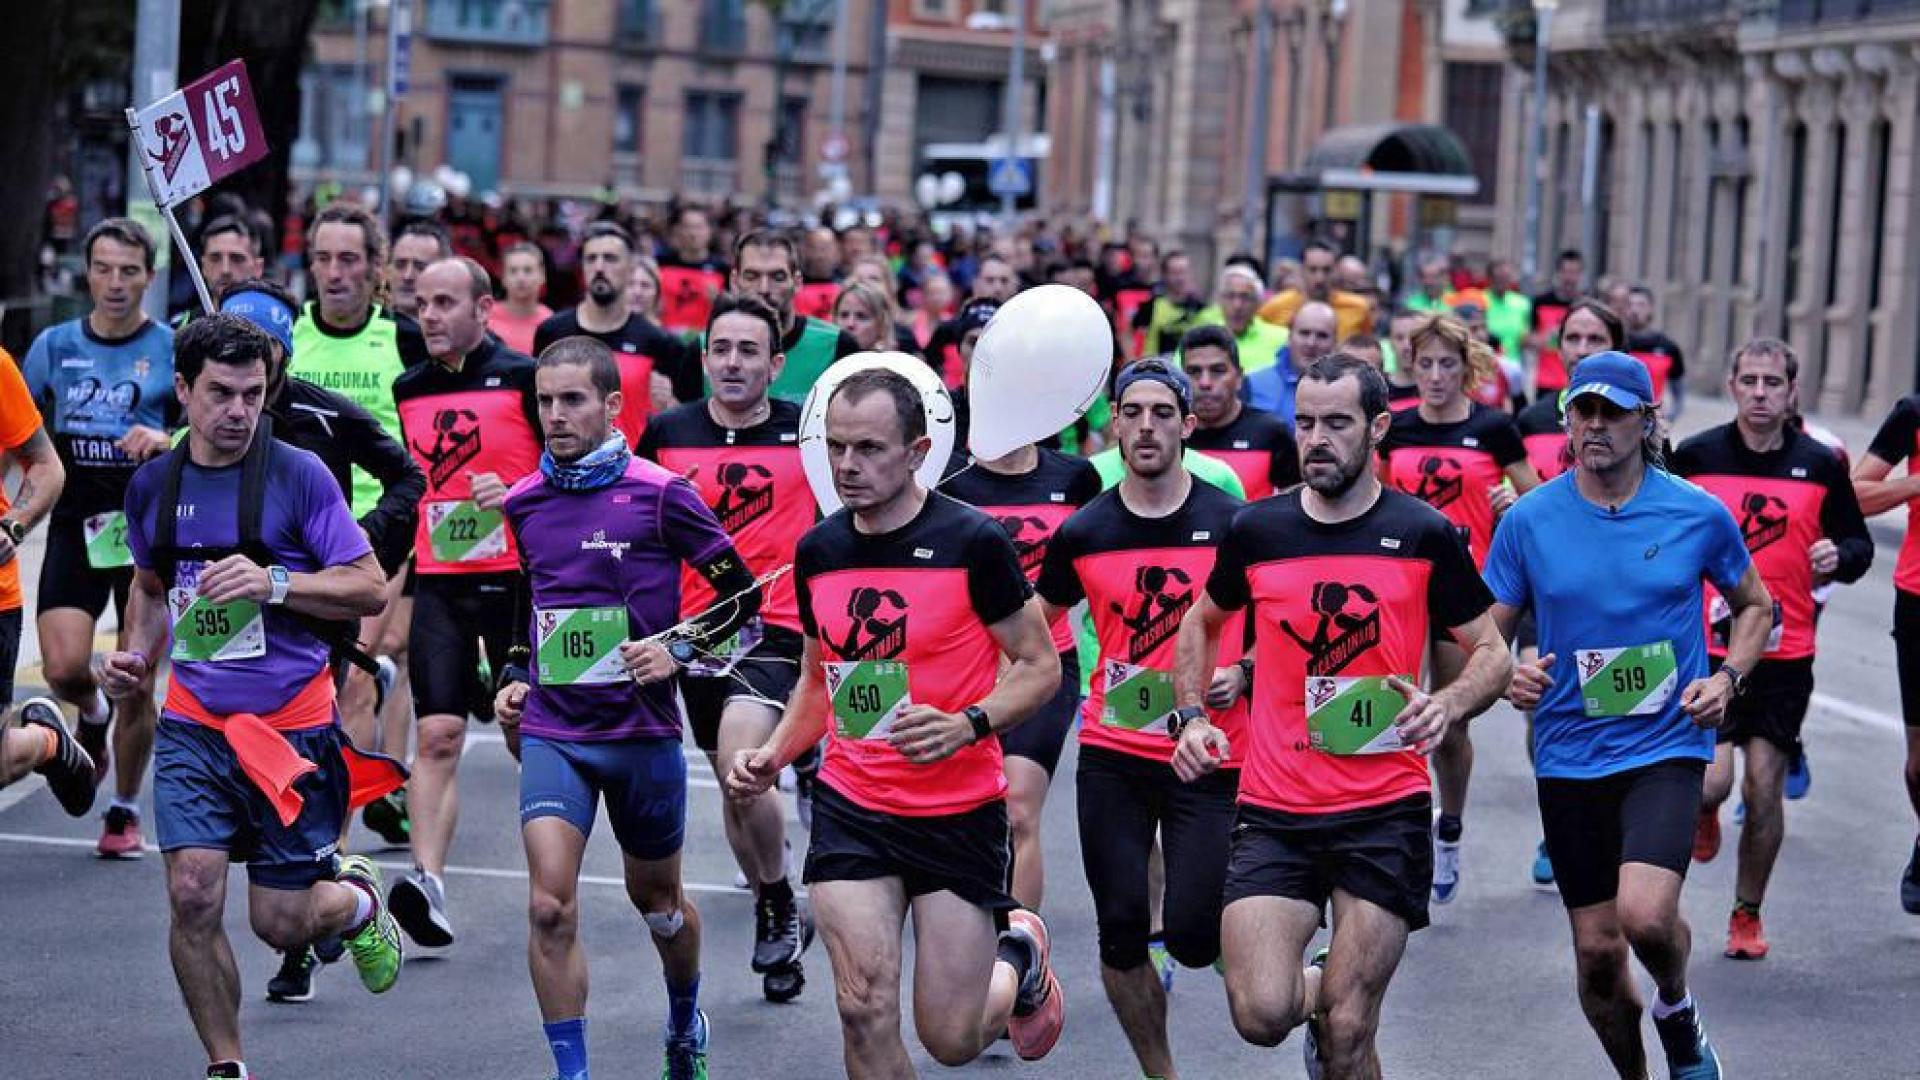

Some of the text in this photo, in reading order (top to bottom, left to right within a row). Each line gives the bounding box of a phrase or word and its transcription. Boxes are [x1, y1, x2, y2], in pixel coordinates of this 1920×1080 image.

[449, 517, 478, 541] 222
[195, 608, 230, 636] 595
[562, 631, 594, 658] 185
[1612, 666, 1645, 693] 519
[849, 683, 882, 713] 450
[1140, 687, 1149, 711] 9
[1350, 699, 1372, 728] 41
